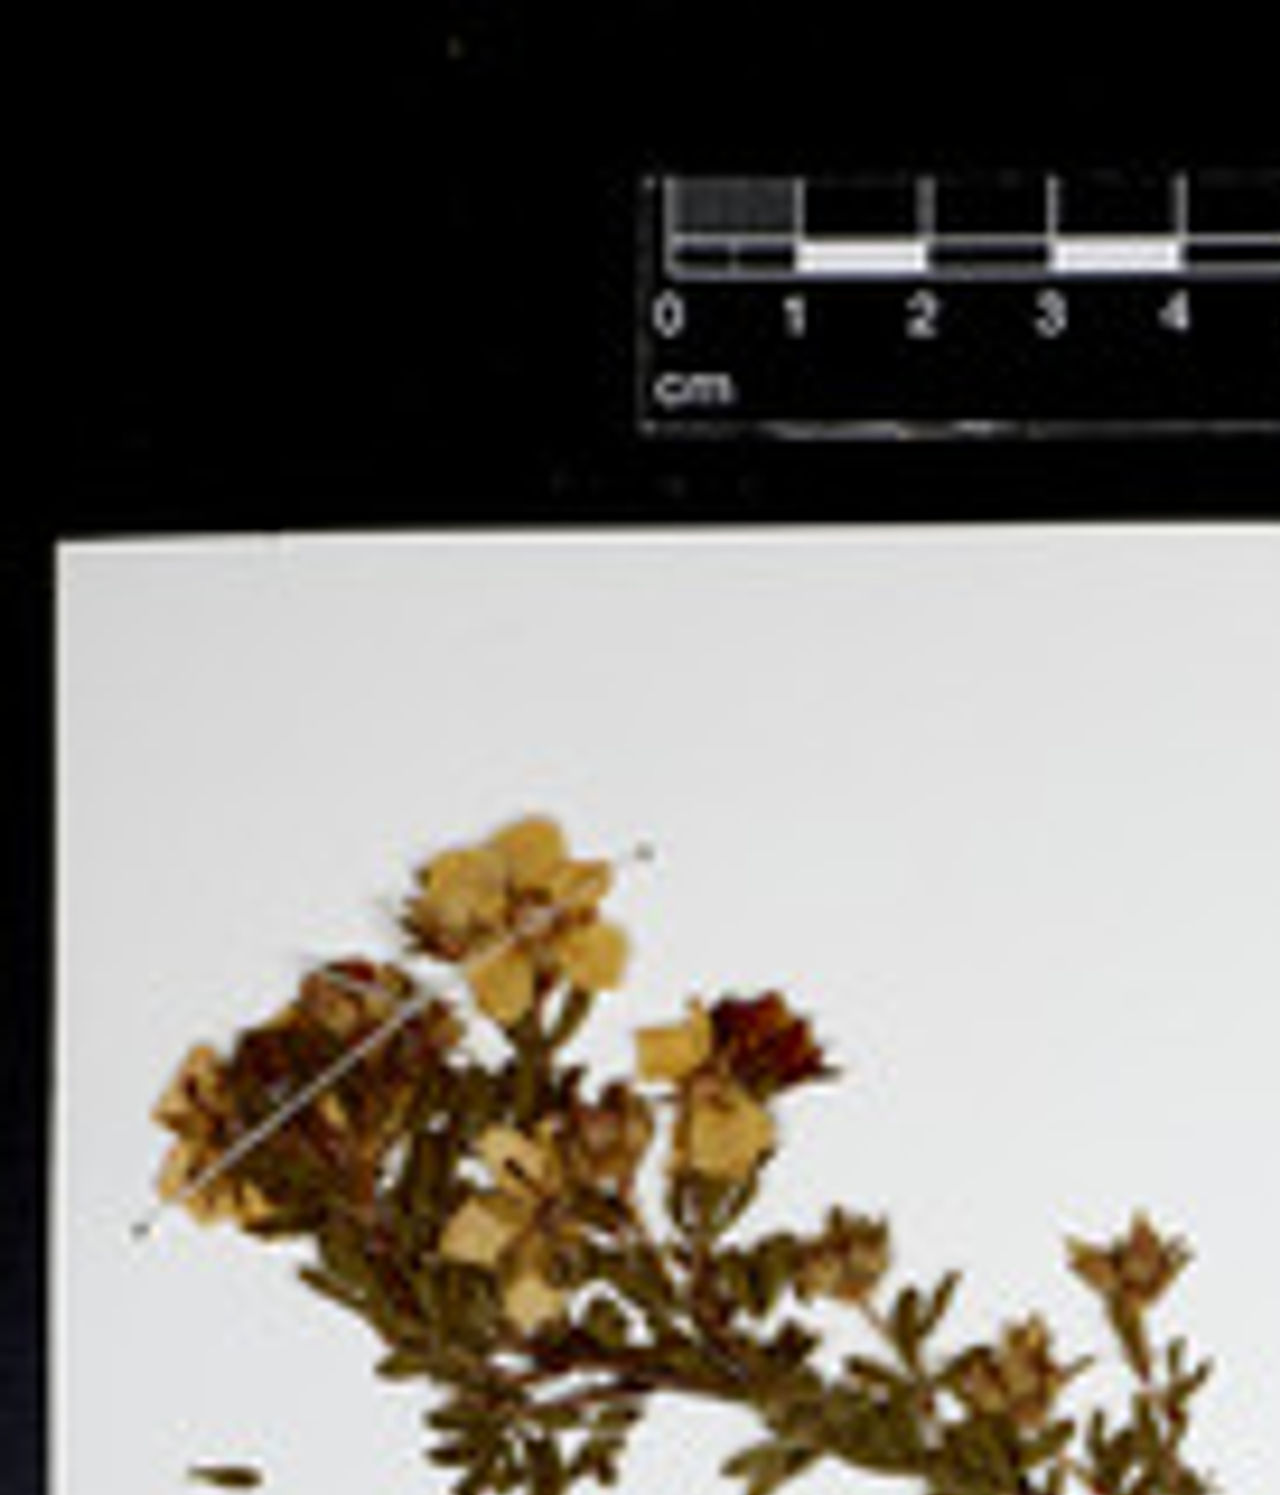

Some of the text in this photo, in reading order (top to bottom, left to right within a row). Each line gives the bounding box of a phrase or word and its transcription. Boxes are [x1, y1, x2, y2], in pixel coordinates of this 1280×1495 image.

[652, 289, 686, 338] 0
[784, 296, 806, 338] 1
[906, 289, 940, 338] 2
[1036, 289, 1068, 338] 3
[1158, 289, 1189, 331] 4
[653, 372, 735, 404] cm
